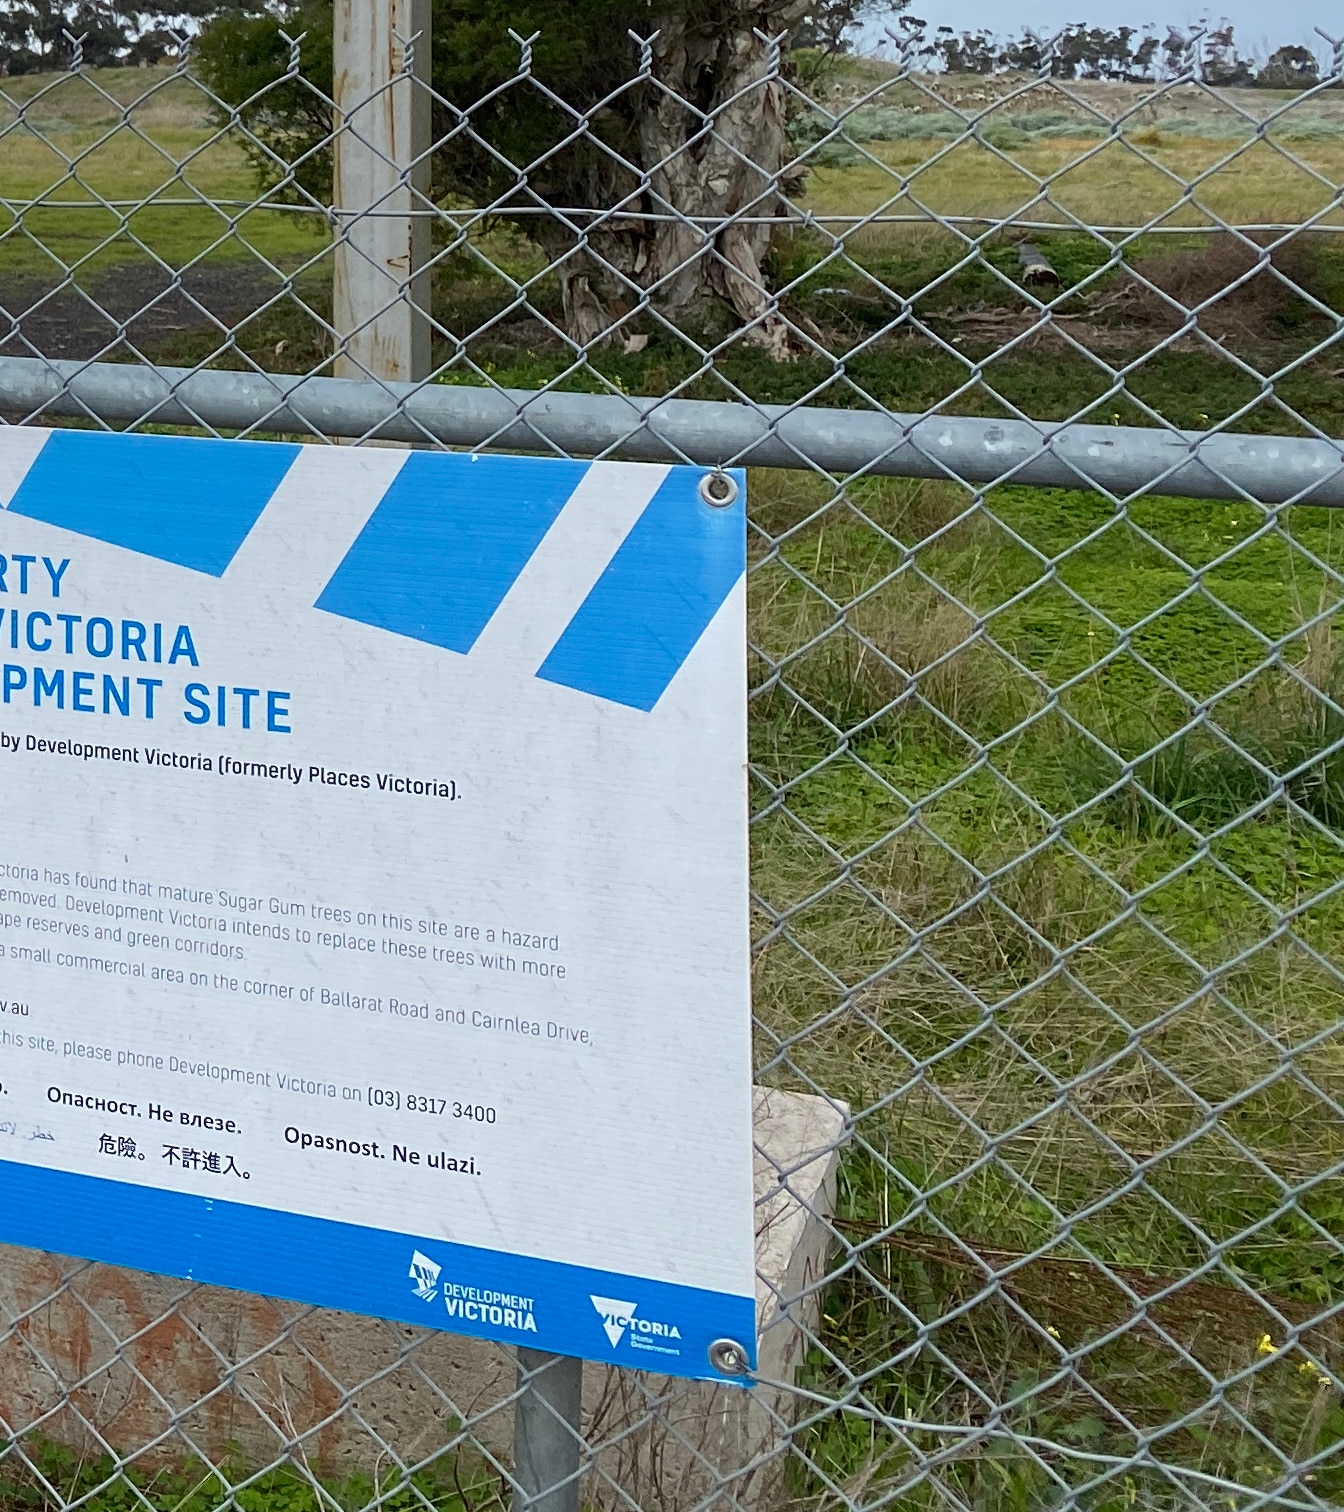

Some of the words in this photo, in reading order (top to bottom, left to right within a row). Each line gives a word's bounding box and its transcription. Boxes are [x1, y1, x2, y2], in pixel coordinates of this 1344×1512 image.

[183, 682, 292, 734] SITE
[0, 731, 21, 753] by
[25, 734, 139, 764] Development
[144, 747, 213, 772] Victoria
[218, 754, 303, 785] (formerly
[308, 766, 371, 789] Places
[375, 773, 462, 801] Victoria).
[43, 867, 70, 886] has
[75, 871, 117, 892] found
[122, 878, 153, 898] that
[157, 885, 214, 905] mature
[217, 888, 264, 913] Sugar
[268, 897, 305, 917] Gum
[311, 903, 351, 927] trees
[356, 911, 377, 926] on
[382, 912, 413, 932] this
[418, 919, 448, 936] site
[454, 924, 480, 941] are
[485, 928, 495, 943] a
[26, 916, 90, 938] reserves
[94, 926, 121, 943] and
[126, 930, 170, 951] green
[65, 894, 164, 924] Development
[168, 908, 227, 932] Victoria
[232, 919, 290, 941] intends
[295, 926, 311, 944] to
[316, 932, 376, 953] replace
[381, 938, 427, 960] these
[432, 946, 475, 966] trees
[480, 952, 517, 972] with
[522, 960, 566, 979] more
[9, 946, 51, 964] small
[56, 952, 146, 978] commercial
[150, 966, 184, 984] area
[189, 972, 208, 987] on
[213, 973, 238, 992] the
[243, 980, 294, 999] corner
[299, 986, 315, 1002] of
[320, 987, 383, 1013] Ballarat
[389, 997, 429, 1019] Road
[434, 1007, 466, 1025] and
[471, 1010, 540, 1036] Cairnlea
[546, 1021, 593, 1047] Drive,
[28, 1036, 58, 1056] site,
[63, 1040, 112, 1062] please
[117, 1048, 164, 1070] phone
[169, 1055, 271, 1088] Development
[276, 1072, 336, 1098] Victoria
[342, 1086, 362, 1102] on
[367, 1086, 401, 1111] (03)
[406, 1094, 447, 1116] 8317
[47, 1086, 141, 1118] Опасност.
[148, 1102, 173, 1123] Не
[179, 1112, 242, 1135] влезе.
[284, 1126, 385, 1159] Opasnost.
[392, 1144, 420, 1165] Ne
[427, 1151, 481, 1176] ulazi.
[445, 1283, 534, 1310] DEVELOPMENT
[445, 1298, 537, 1332] VICTORIA
[598, 1312, 682, 1340] VICTORIA
